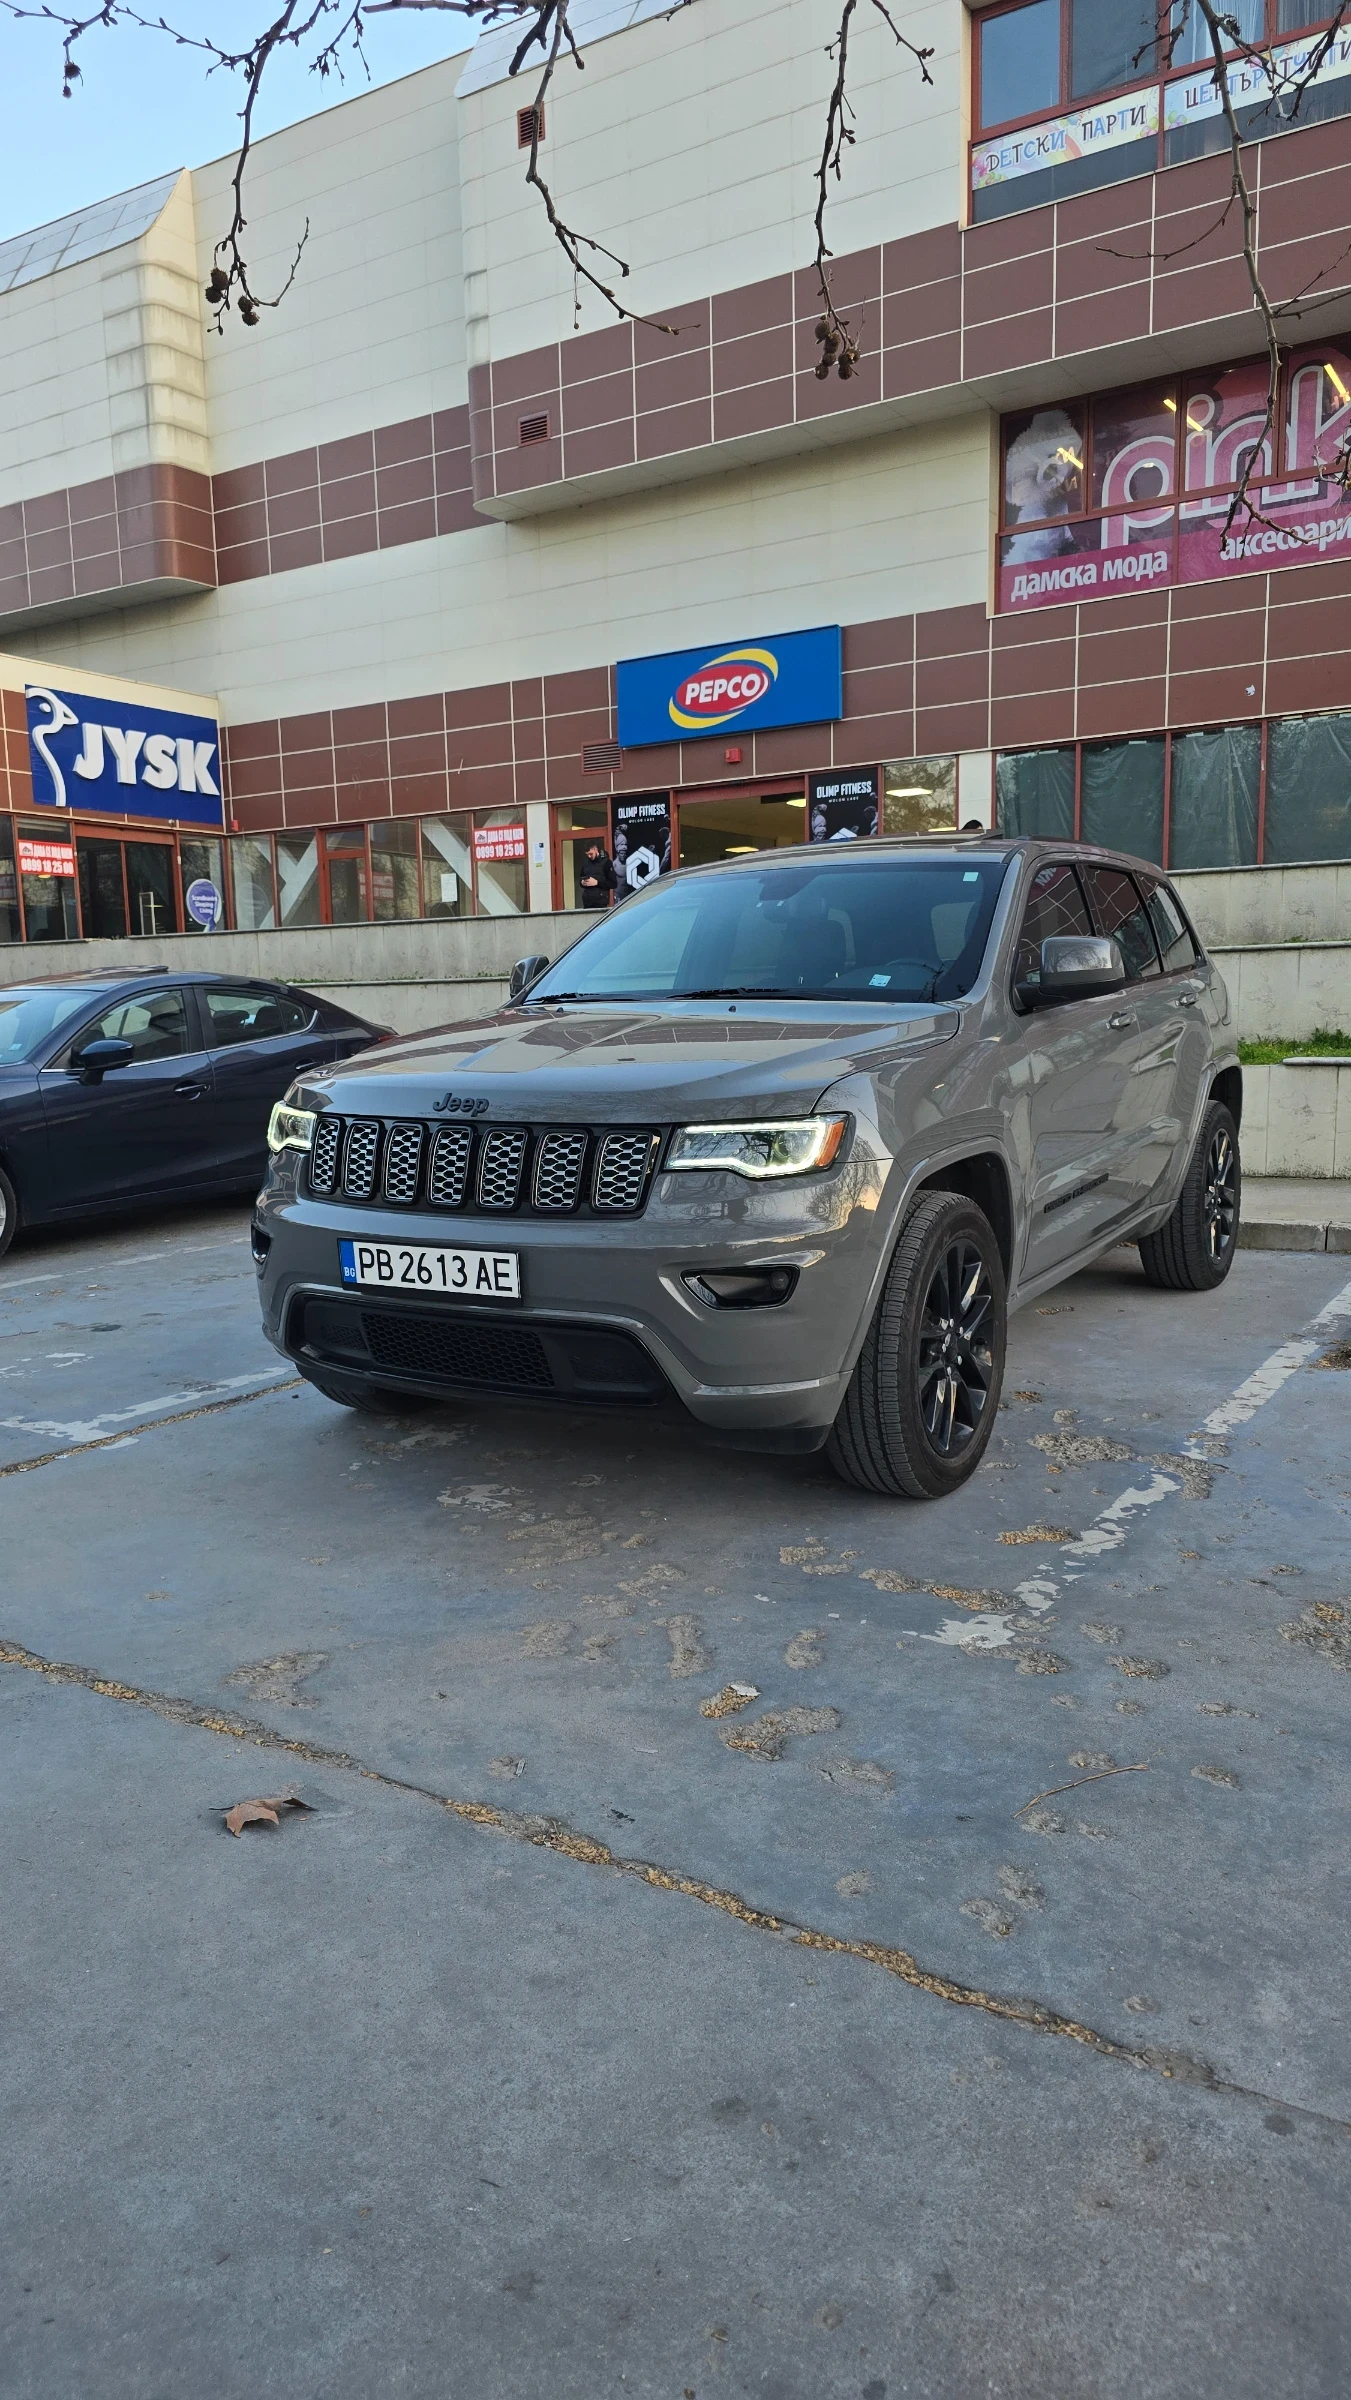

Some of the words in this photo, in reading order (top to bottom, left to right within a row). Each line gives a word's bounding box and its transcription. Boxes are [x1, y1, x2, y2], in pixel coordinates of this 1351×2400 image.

[1081, 104, 1147, 141] ПАРТИ
[1101, 364, 1351, 550] pink
[1220, 516, 1351, 560] аксесоари
[1011, 563, 1097, 602] дамска
[1102, 551, 1168, 582] мода
[685, 673, 761, 705] PEPCO
[72, 722, 220, 796] JYSK
[816, 785, 840, 799] OLIMP
[840, 780, 872, 796] FITNESS
[618, 806, 638, 819] OLIMP
[639, 803, 666, 817] FITNESS
[504, 843, 514, 856] 25
[514, 842, 525, 856] 00
[52, 860, 63, 874] 25
[433, 1093, 489, 1117] Jeep
[343, 1266, 356, 1278] BG
[358, 1247, 394, 1281] PB
[399, 1251, 468, 1288] 2613
[476, 1257, 513, 1292] AE
